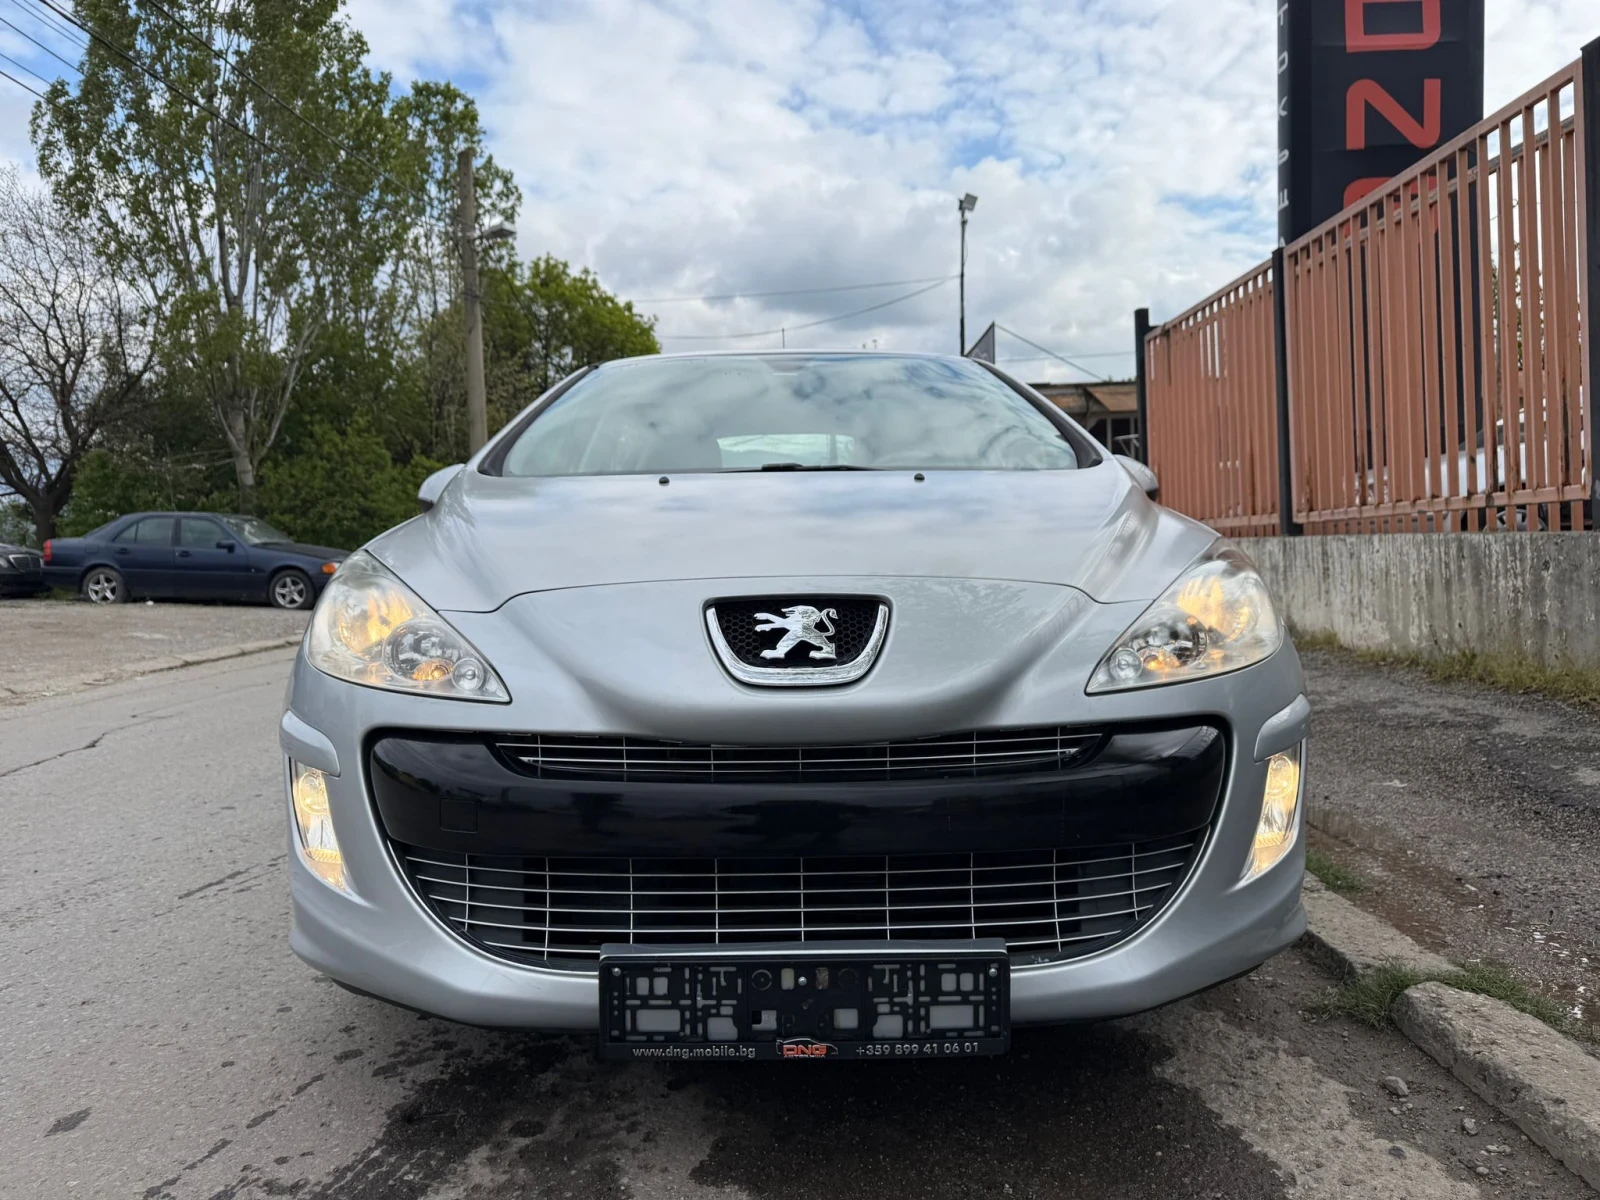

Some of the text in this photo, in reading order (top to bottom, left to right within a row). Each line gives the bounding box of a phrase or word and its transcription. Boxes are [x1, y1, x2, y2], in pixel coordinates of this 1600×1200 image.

[632, 1045, 756, 1059] www.dng.mobile.bg
[782, 1044, 827, 1055] DNG
[856, 1042, 979, 1056] +359 899 41 06 01
